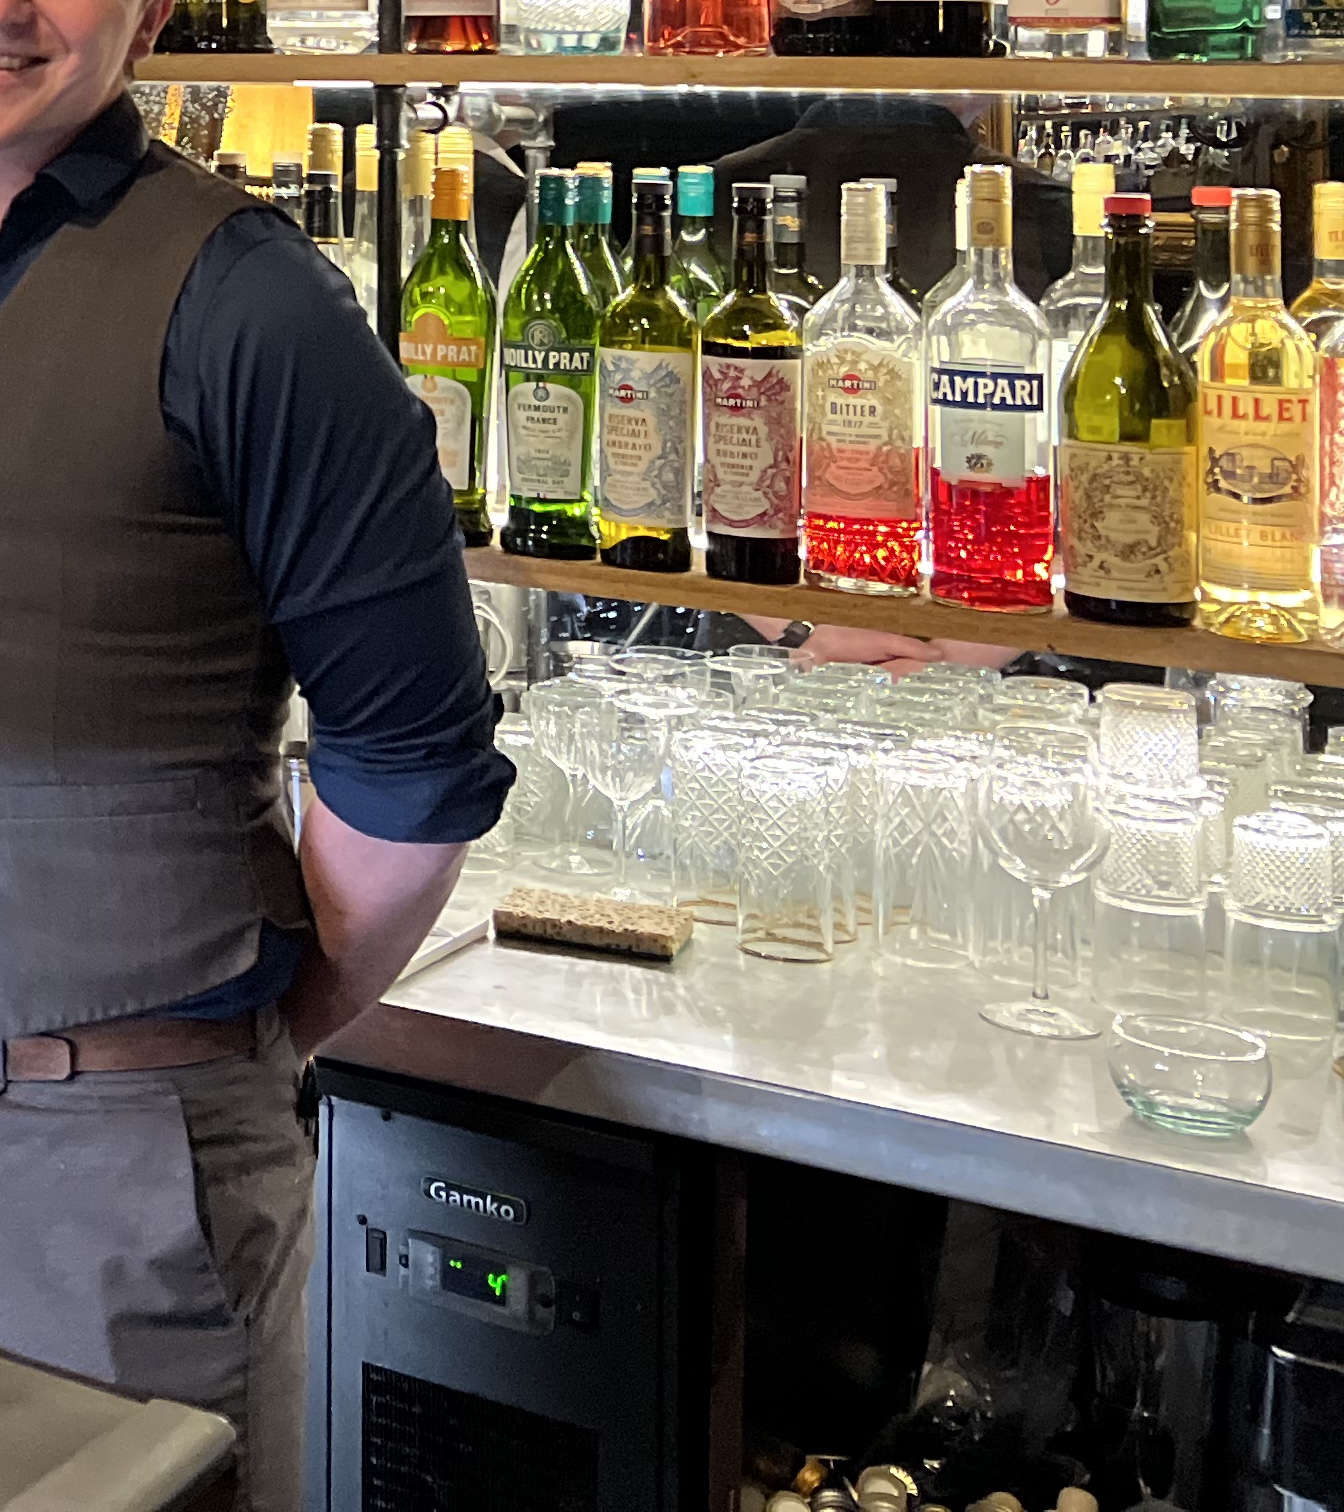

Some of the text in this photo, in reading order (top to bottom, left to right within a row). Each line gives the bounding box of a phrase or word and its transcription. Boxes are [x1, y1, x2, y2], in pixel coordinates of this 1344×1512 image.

[436, 344, 477, 362] PRAT
[548, 350, 590, 371] PRAT
[829, 378, 876, 390] MARTINI
[930, 375, 1040, 407] CAMPARI
[609, 389, 649, 401] MARTINI
[715, 398, 759, 409] MARTINI
[830, 402, 877, 418] BITTER
[1203, 392, 1310, 423] LILLET
[429, 1182, 515, 1221] Gamko
